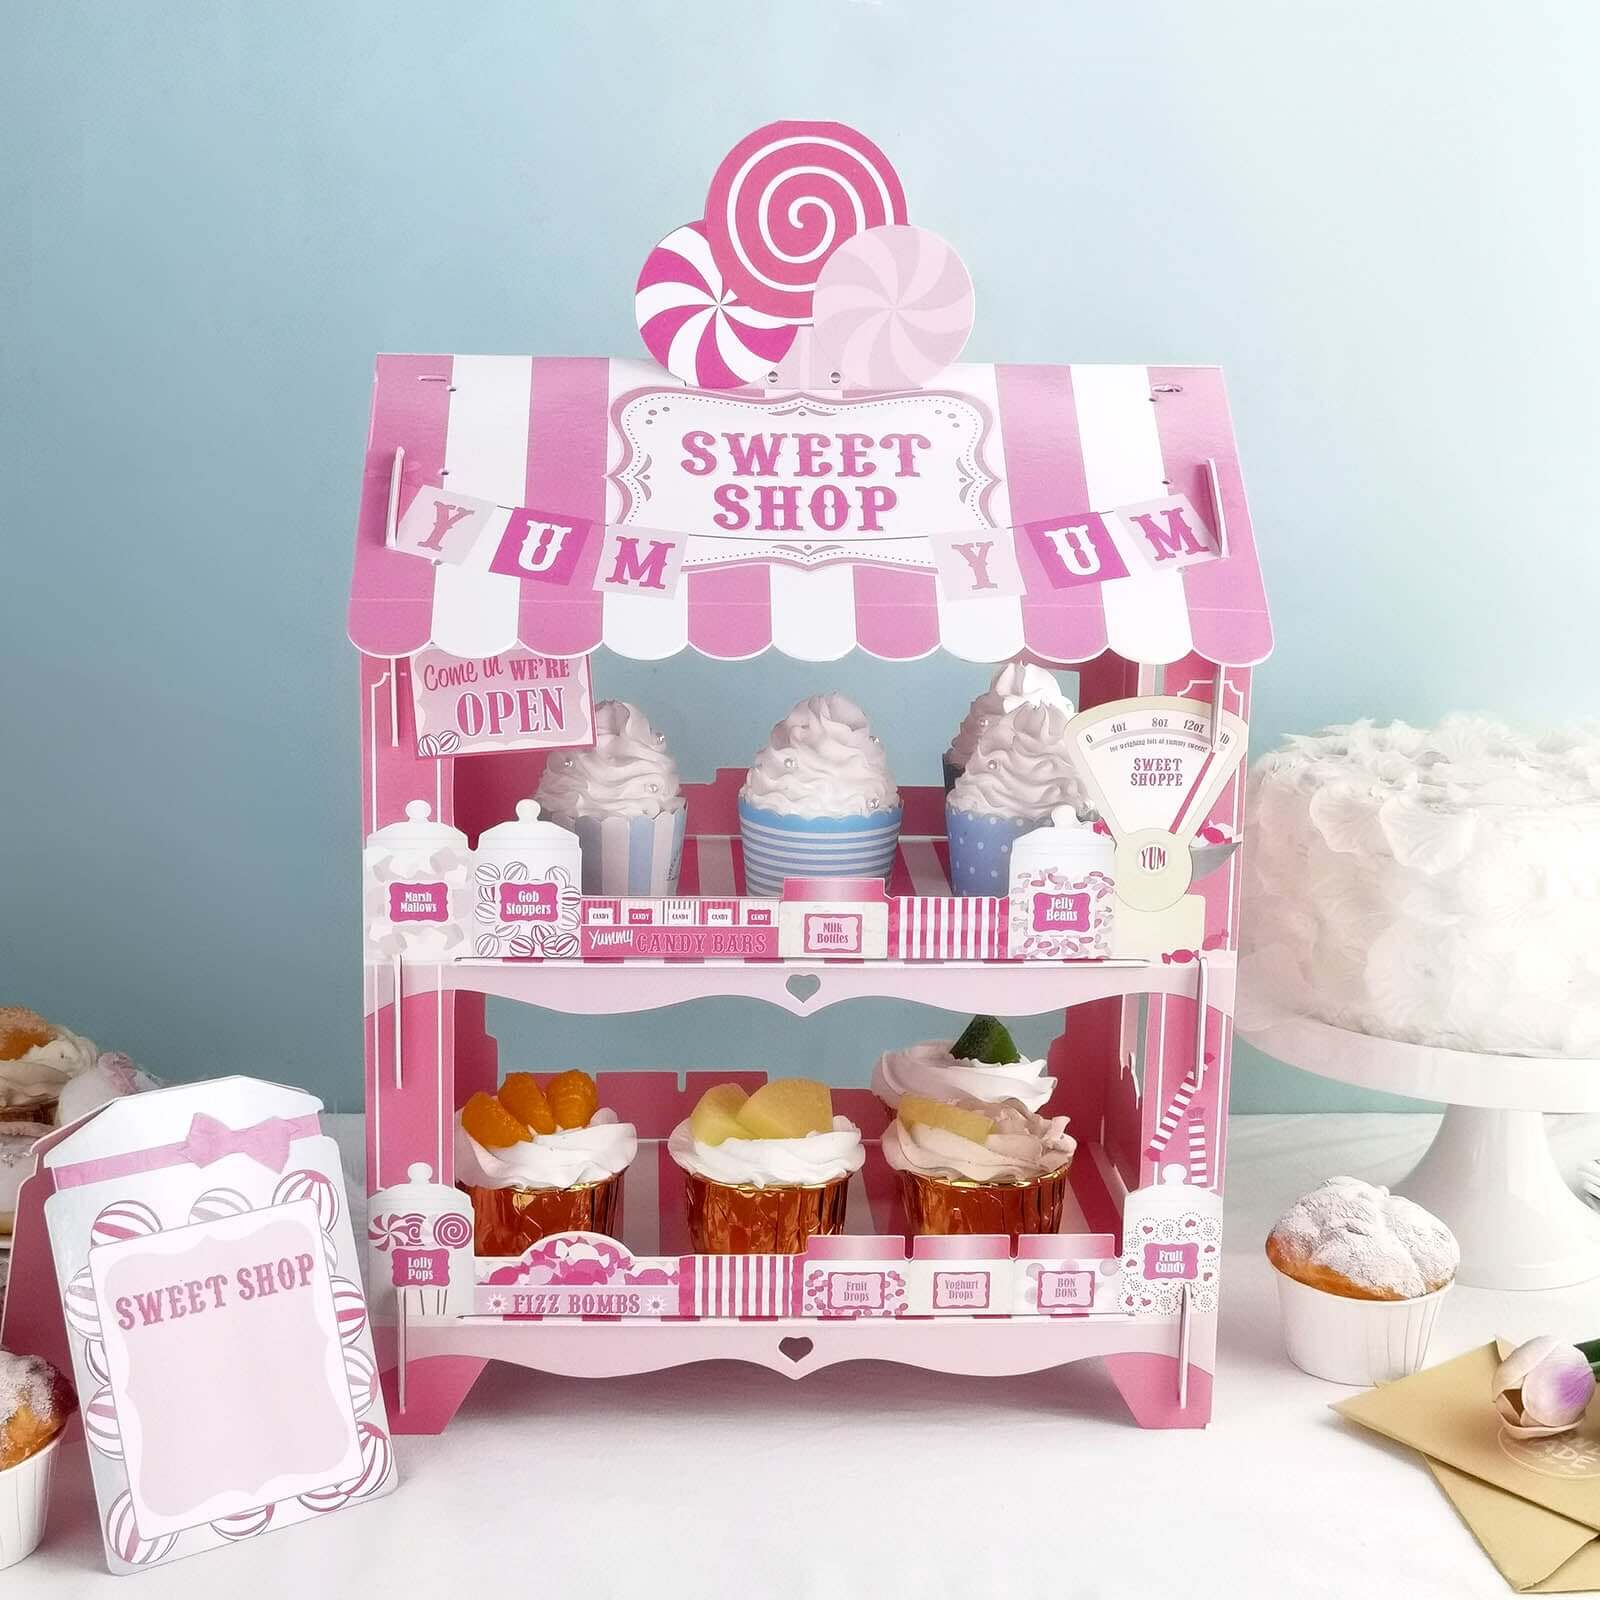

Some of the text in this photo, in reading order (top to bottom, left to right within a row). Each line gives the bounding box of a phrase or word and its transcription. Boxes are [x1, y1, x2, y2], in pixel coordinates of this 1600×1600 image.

[680, 430, 932, 478] SWEET
[712, 483, 898, 532] SHOP
[423, 656, 571, 691] Come in WE'RE
[456, 687, 565, 737] OPEN
[1133, 757, 1183, 772] SWEET
[1130, 773, 1183, 787] SHOPPE
[1141, 846, 1166, 871] YUM
[404, 891, 432, 902] Marsh
[518, 890, 539, 903] Gob
[400, 902, 438, 913] Mallows
[505, 902, 551, 917] Stoppers
[1049, 897, 1075, 911] Jelly
[1046, 909, 1078, 921] Beans
[822, 922, 843, 933] Milk
[588, 929, 768, 953] Yummy CANDY BARS
[817, 933, 849, 944] Bottles
[1158, 1250, 1183, 1262] Fruit
[407, 1257, 433, 1270] Lolly
[1155, 1261, 1186, 1274] Candy
[407, 1268, 434, 1281] Pops
[846, 1281, 867, 1292] Fruit
[944, 1279, 979, 1291] Yoghurt
[1057, 1278, 1076, 1288] BON
[115, 1252, 315, 1331] SWEET SHOP
[843, 1291, 869, 1302] Drops
[948, 1289, 974, 1300] Drops
[1055, 1288, 1078, 1298] BONS
[512, 1293, 641, 1314] FIZZ BOMBS
